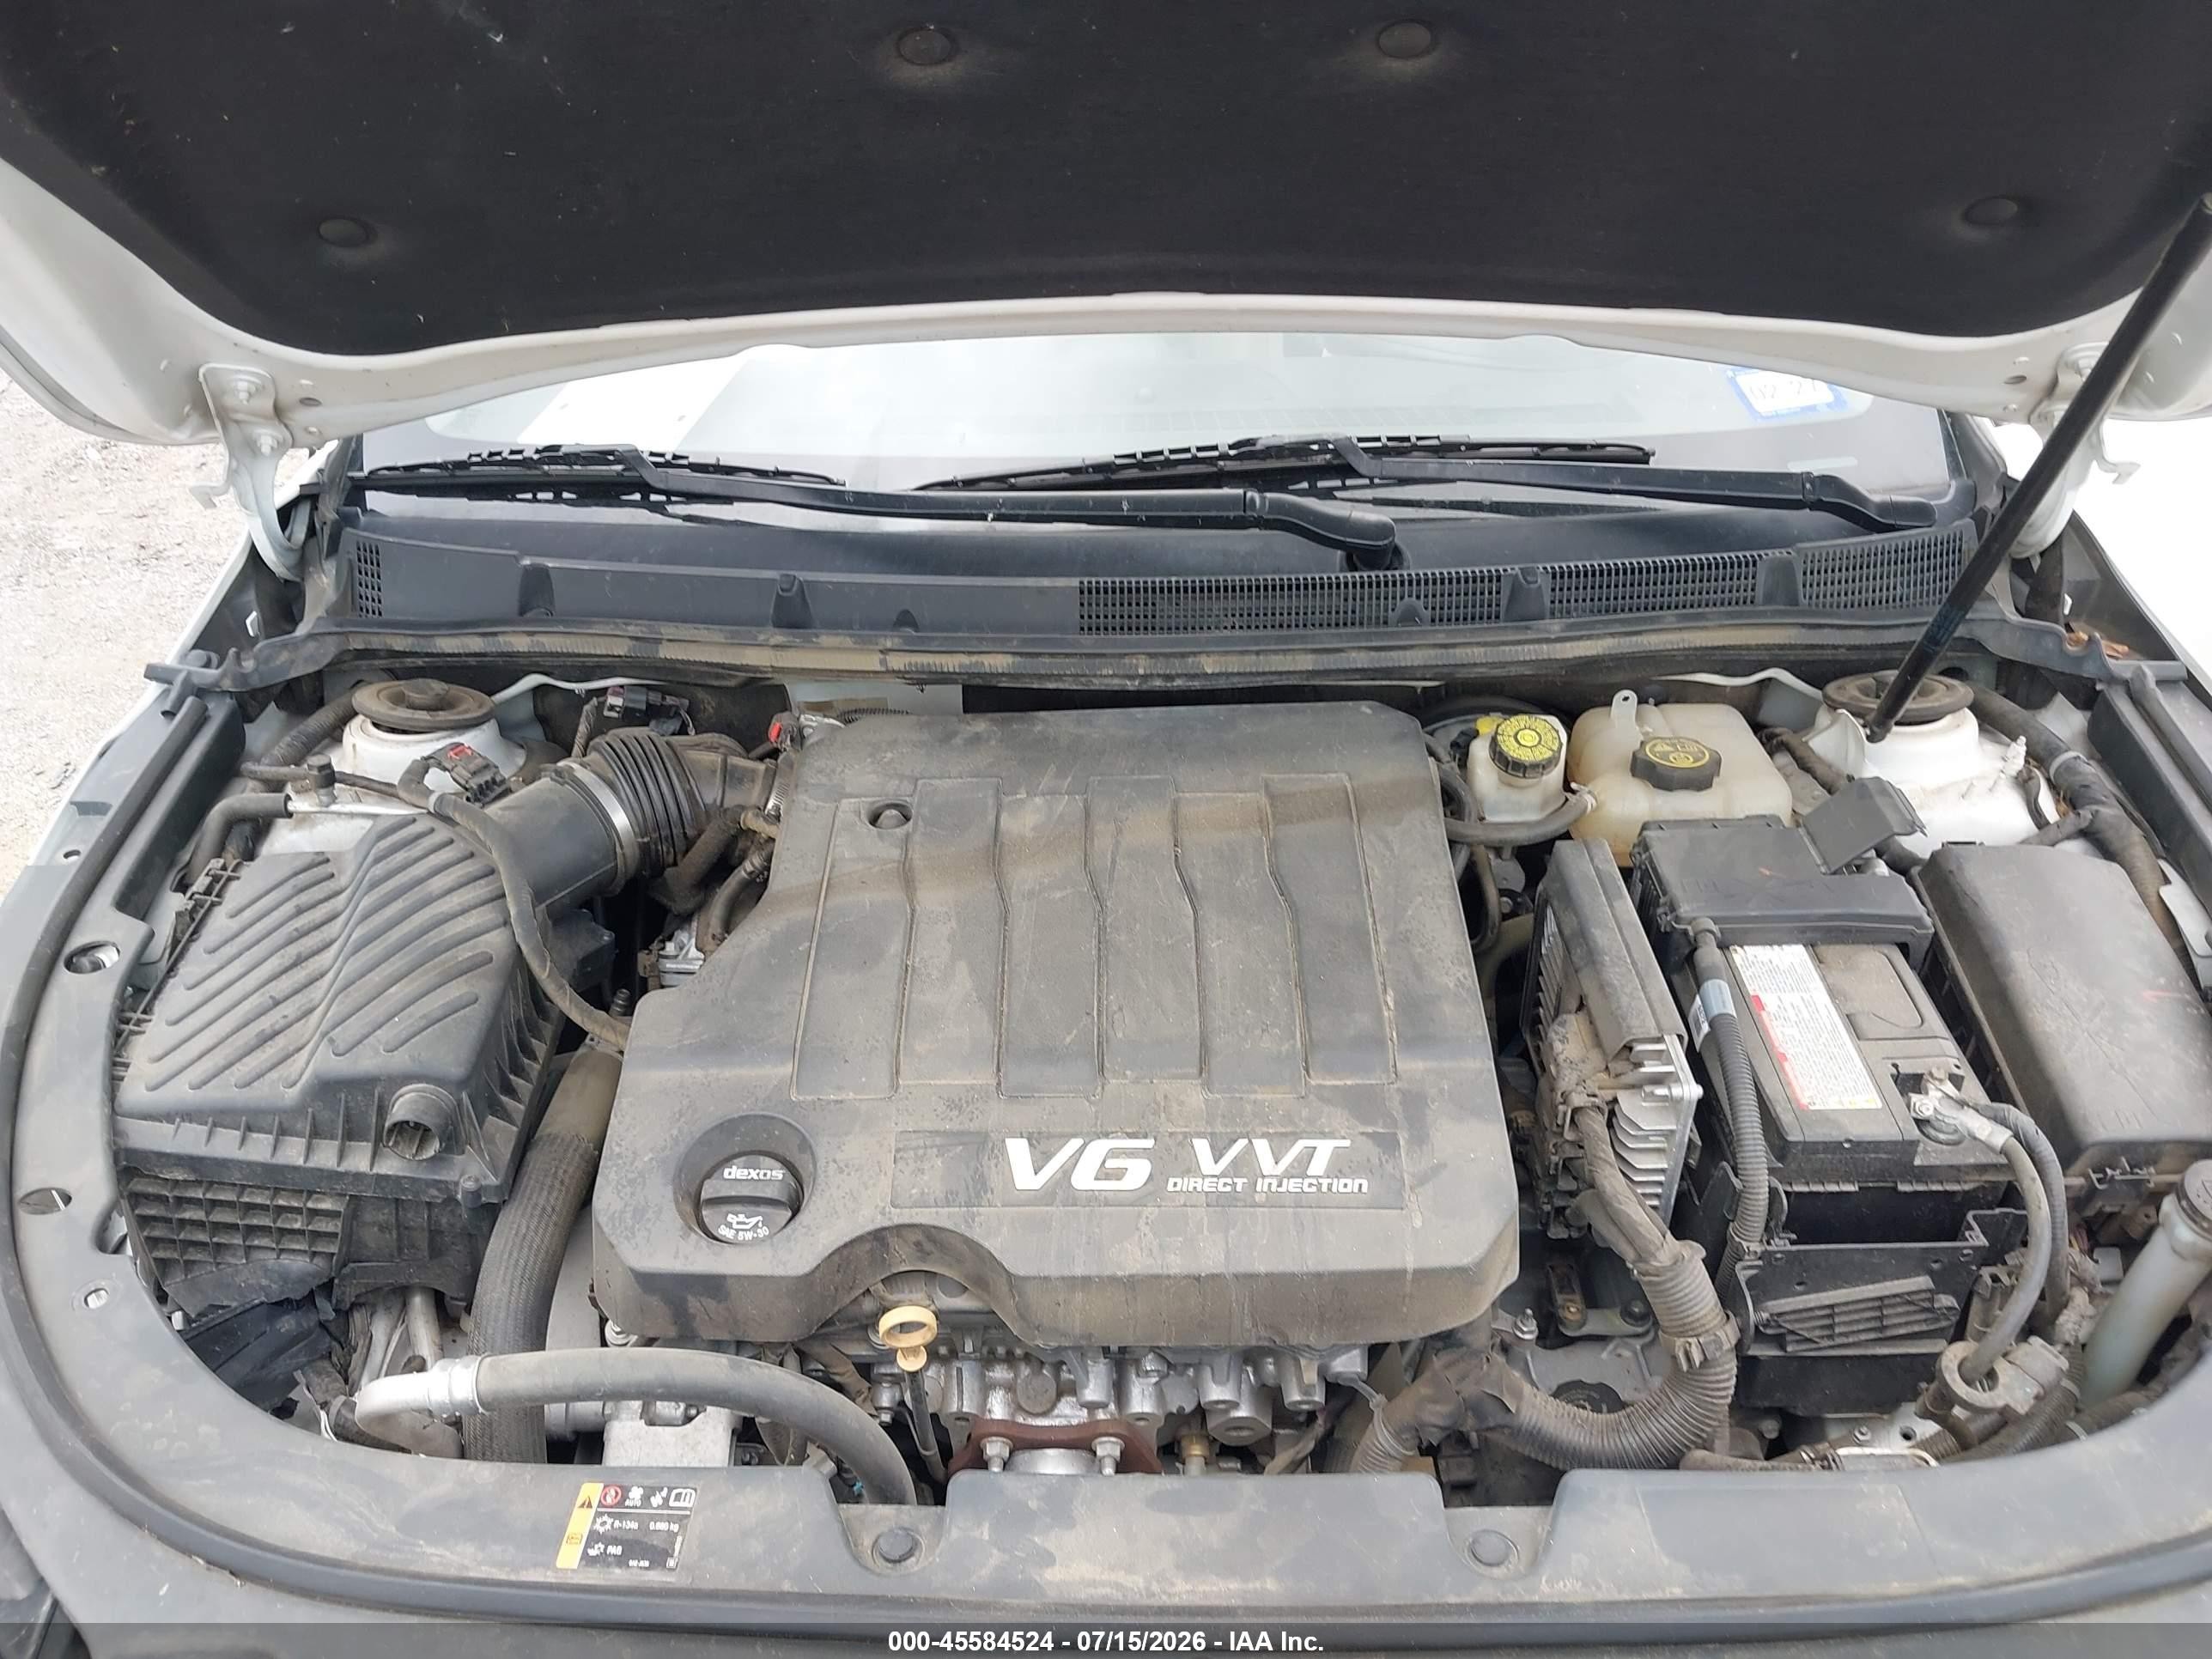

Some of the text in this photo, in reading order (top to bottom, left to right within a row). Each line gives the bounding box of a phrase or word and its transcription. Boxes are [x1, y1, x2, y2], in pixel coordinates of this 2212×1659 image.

[1005, 1137, 1351, 1191] V6 VVT
[723, 1165, 784, 1180] dexos
[1167, 1177, 1368, 1193] DIRECT INJECTION
[718, 1224, 737, 1240] SAE
